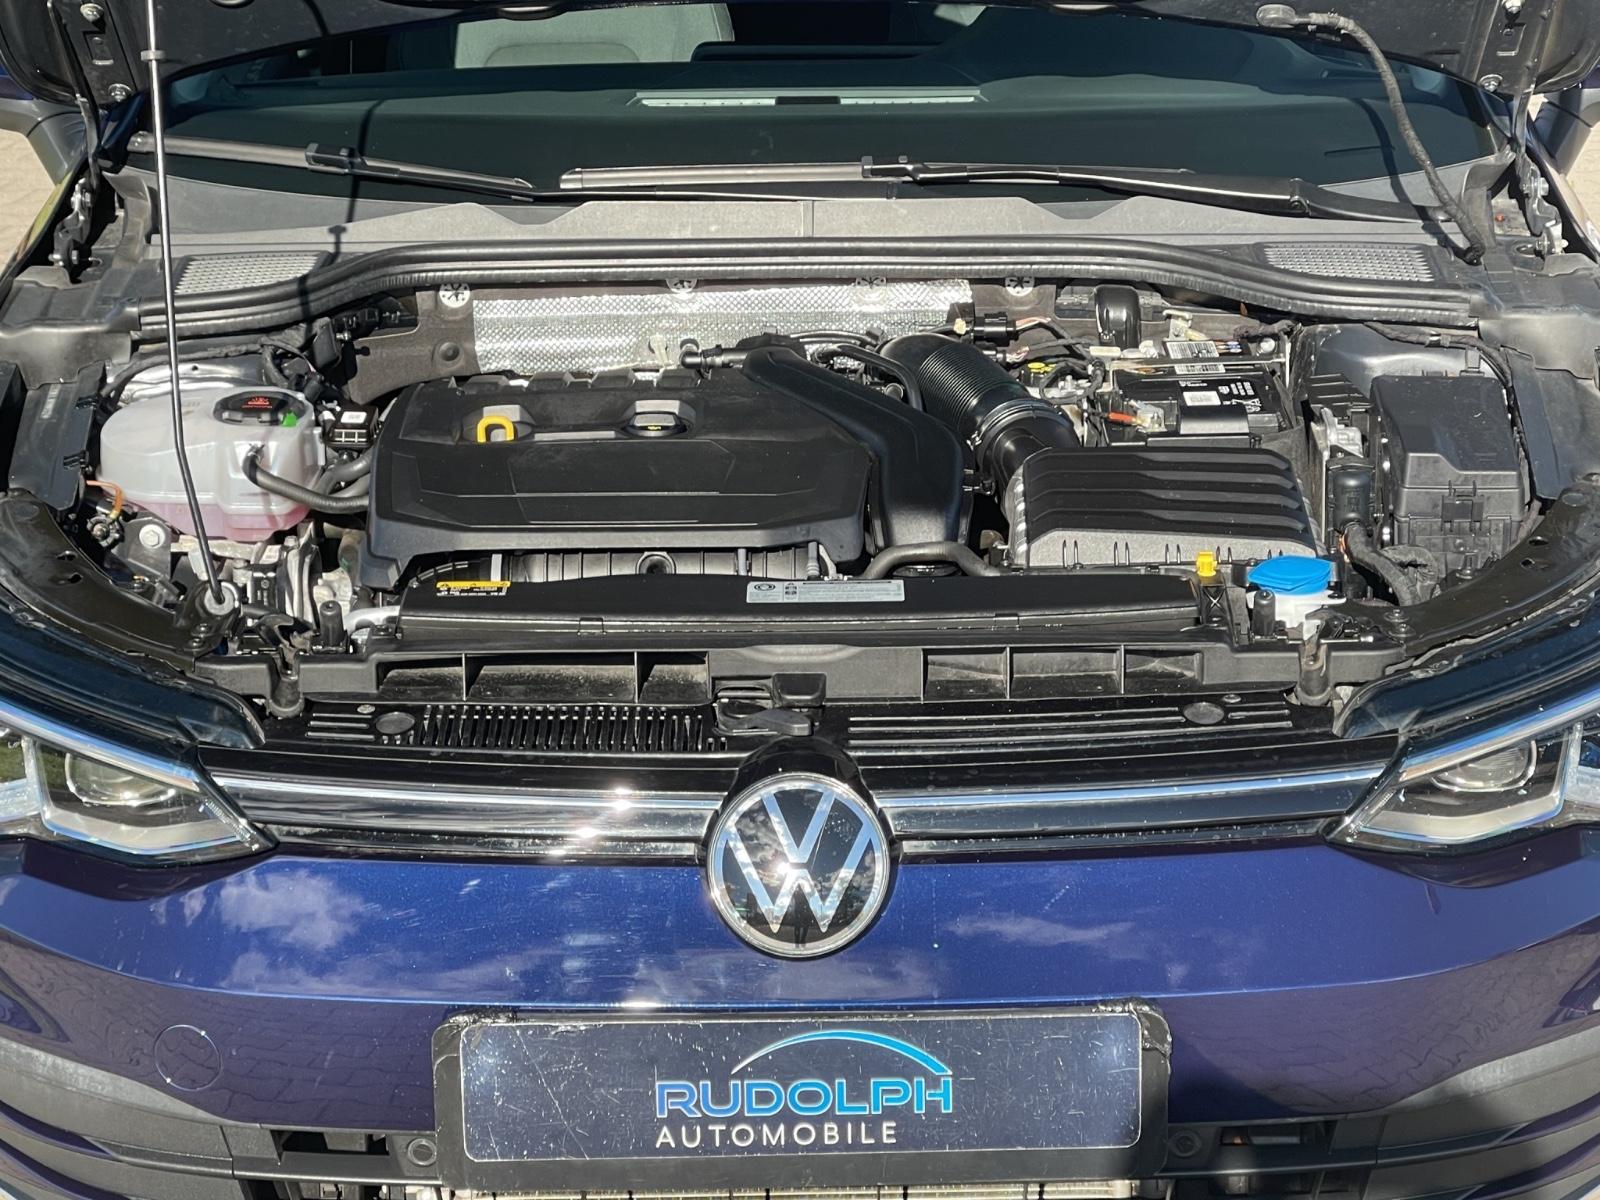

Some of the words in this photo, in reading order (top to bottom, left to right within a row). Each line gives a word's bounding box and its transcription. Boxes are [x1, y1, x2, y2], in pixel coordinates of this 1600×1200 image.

[718, 783, 878, 938] VW
[655, 1076, 954, 1119] RUDOLPH
[655, 1120, 898, 1149] AUTOMOBILE
